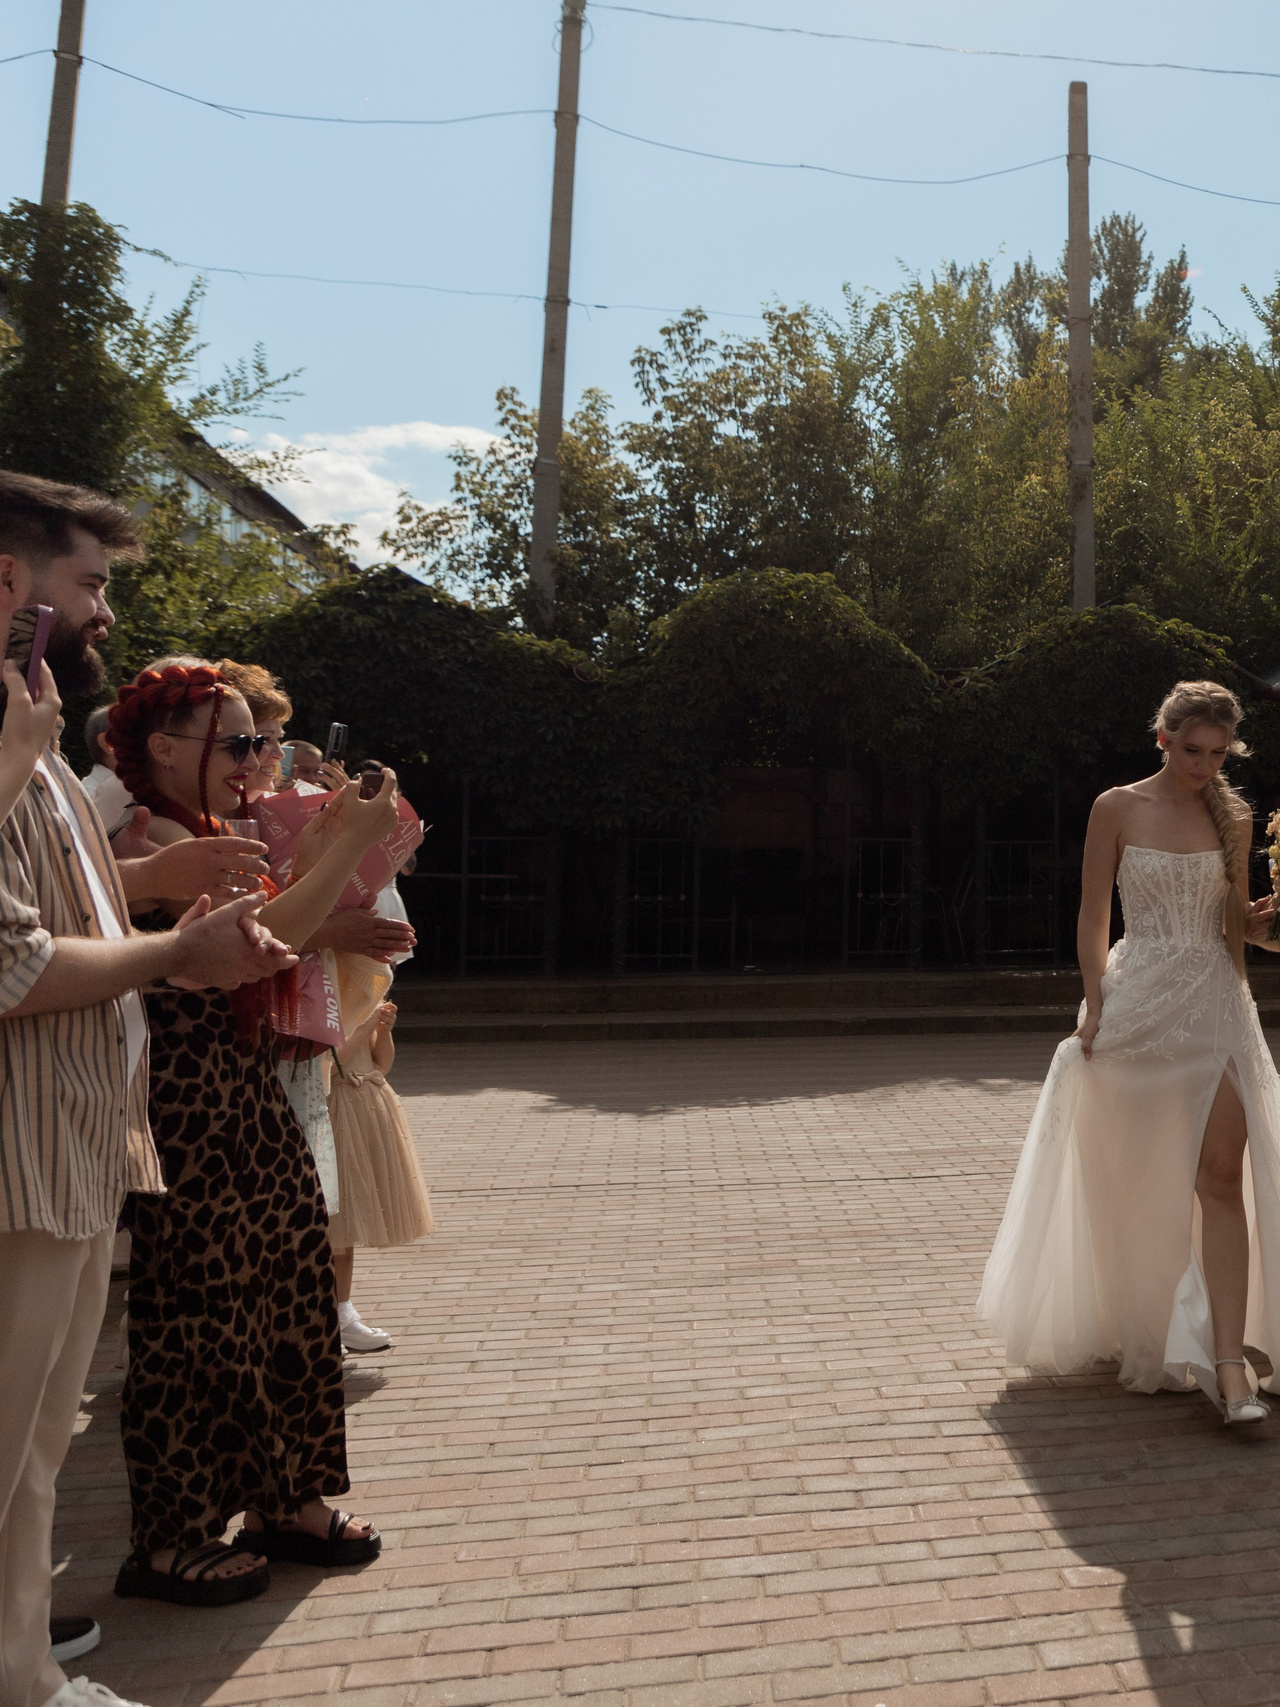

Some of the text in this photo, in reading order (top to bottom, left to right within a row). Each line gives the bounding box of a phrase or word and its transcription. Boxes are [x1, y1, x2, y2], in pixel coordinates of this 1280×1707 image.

[398, 820, 418, 843] All
[351, 872, 369, 896] HILE
[326, 998, 340, 1033] ONE
